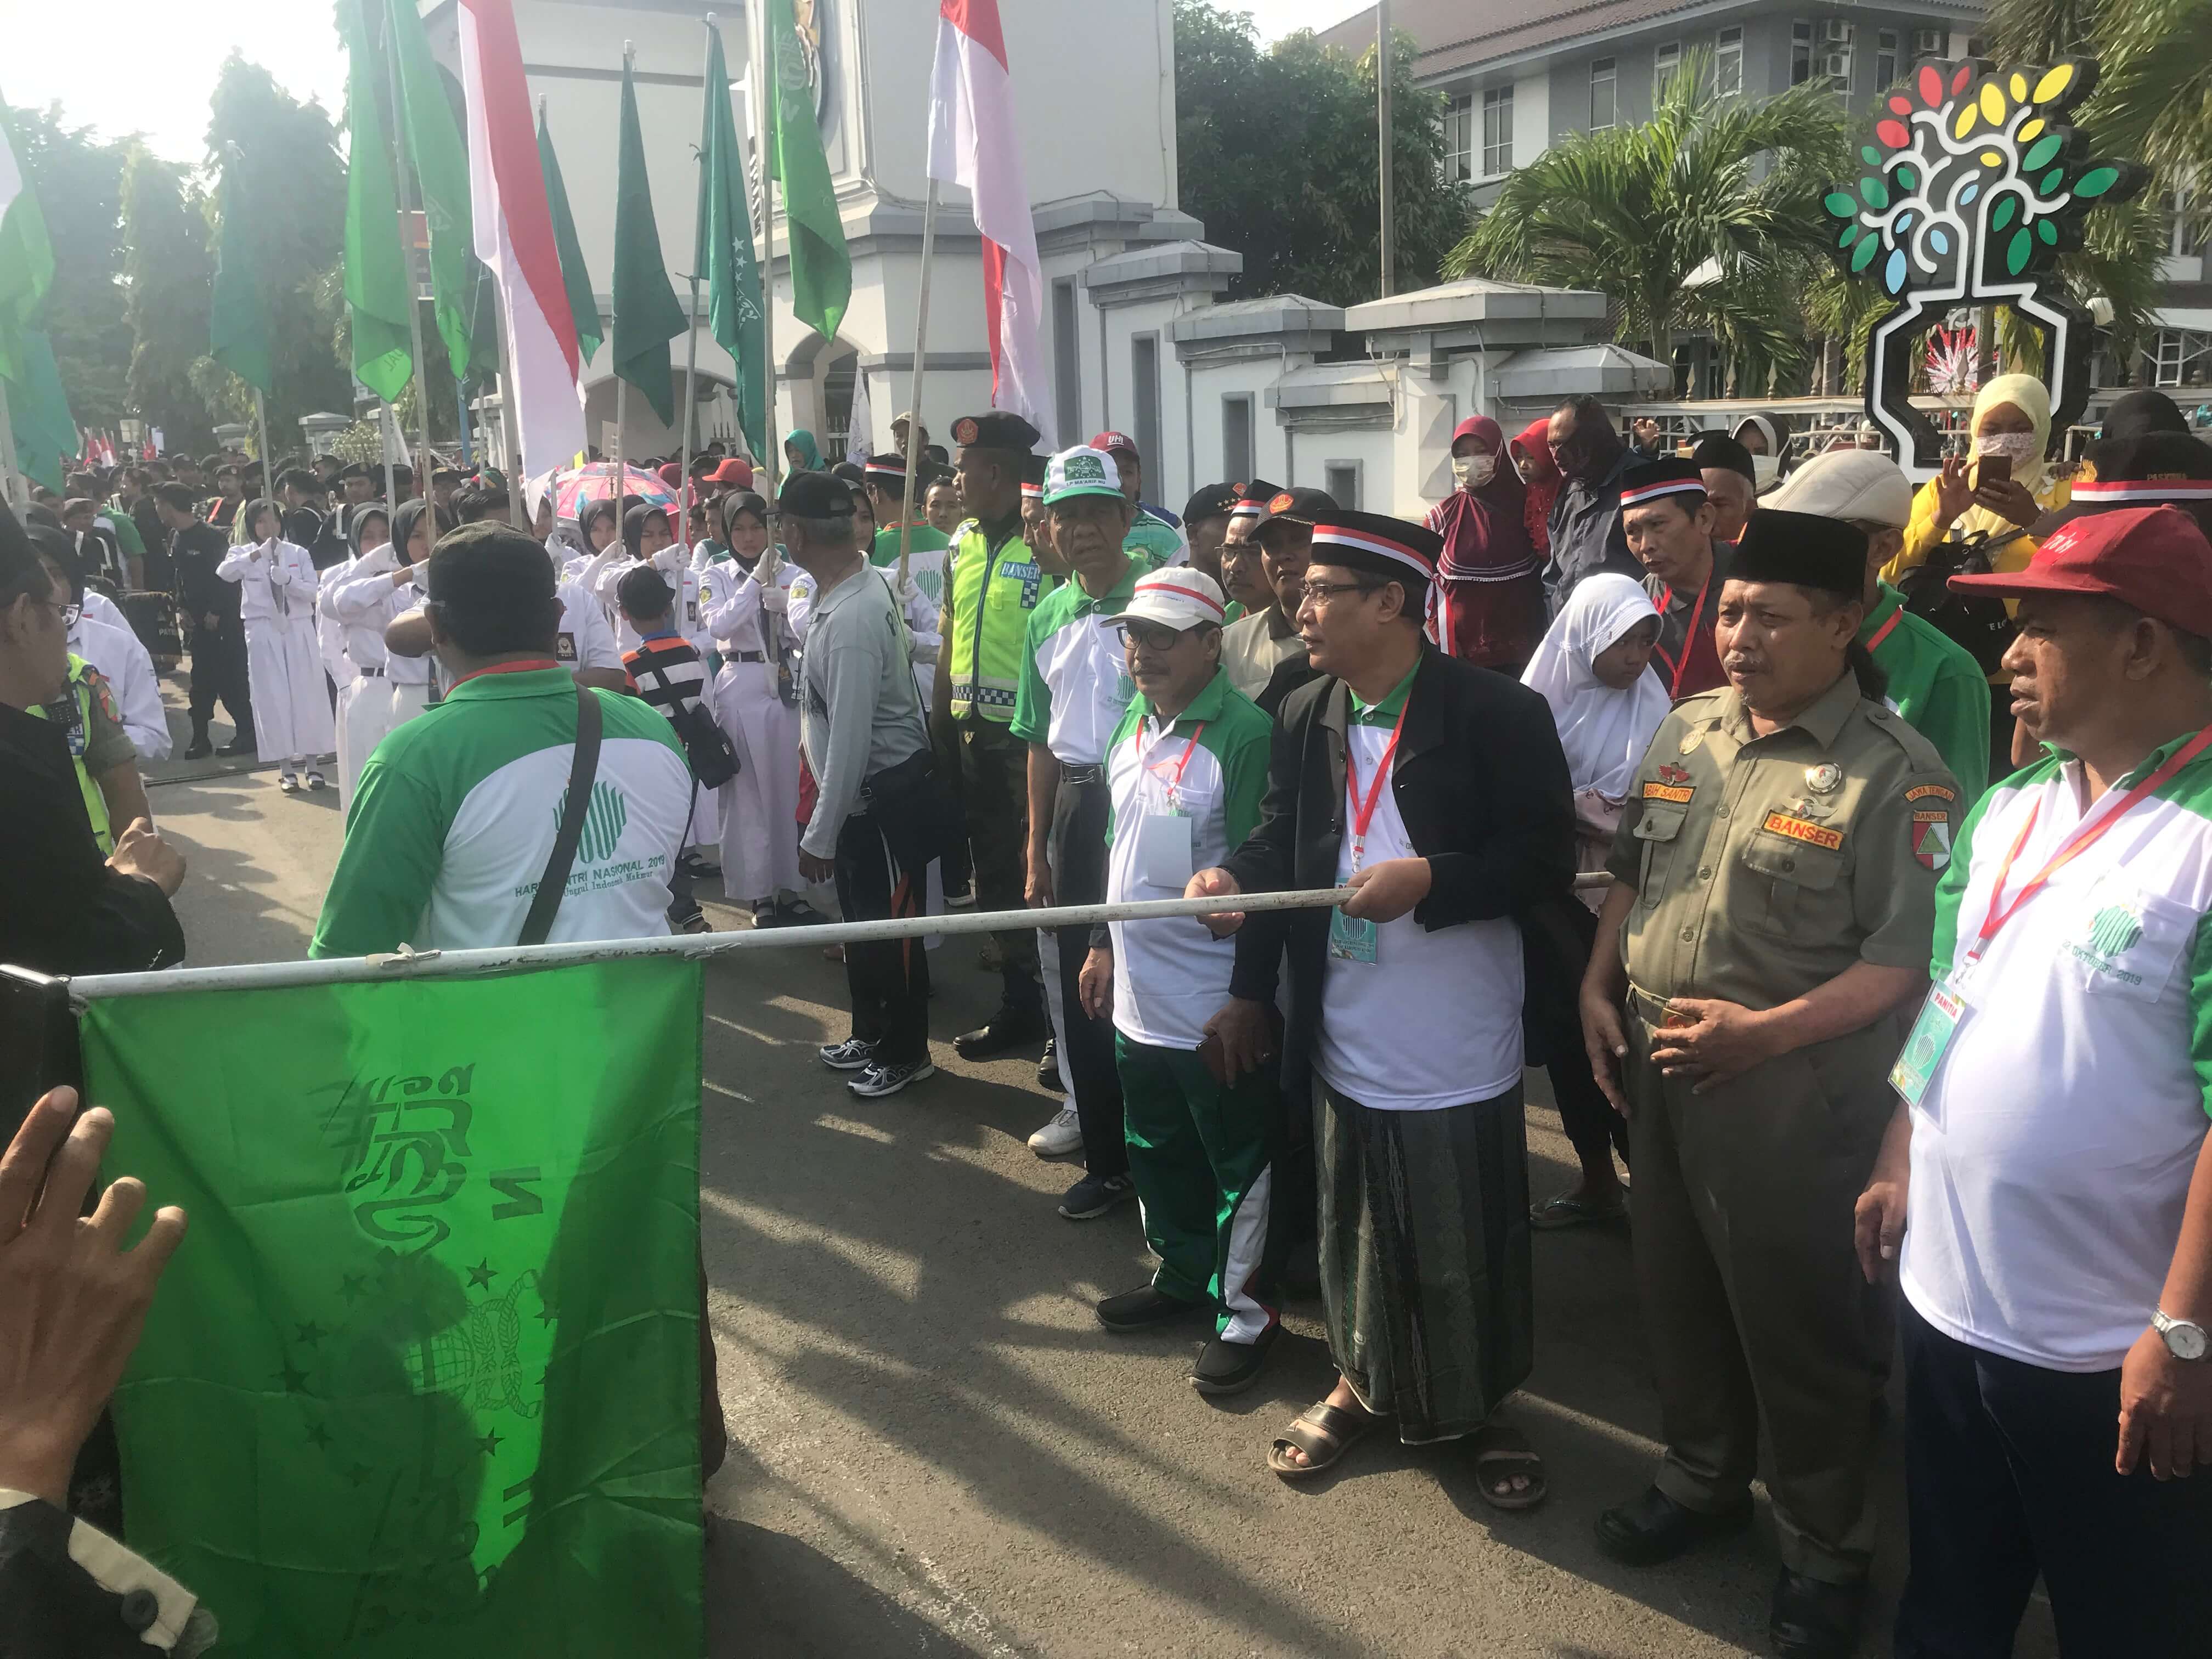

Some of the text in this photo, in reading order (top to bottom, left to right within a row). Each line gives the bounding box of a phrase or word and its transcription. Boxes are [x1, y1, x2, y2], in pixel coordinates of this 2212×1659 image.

[1001, 562, 1040, 580] BANSER
[1910, 786, 1954, 800] JAWA TENGAH
[1914, 812, 1946, 821] BANSER
[1769, 815, 1838, 848] BANSER
[515, 882, 540, 897] HAR
[567, 872, 588, 885] NTRI
[593, 860, 644, 879] NASIONAL
[648, 855, 665, 868] 2019
[2072, 945, 2112, 975] OKTOBER
[2116, 969, 2142, 985] 2019
[1934, 992, 1958, 1019] PANITIA
